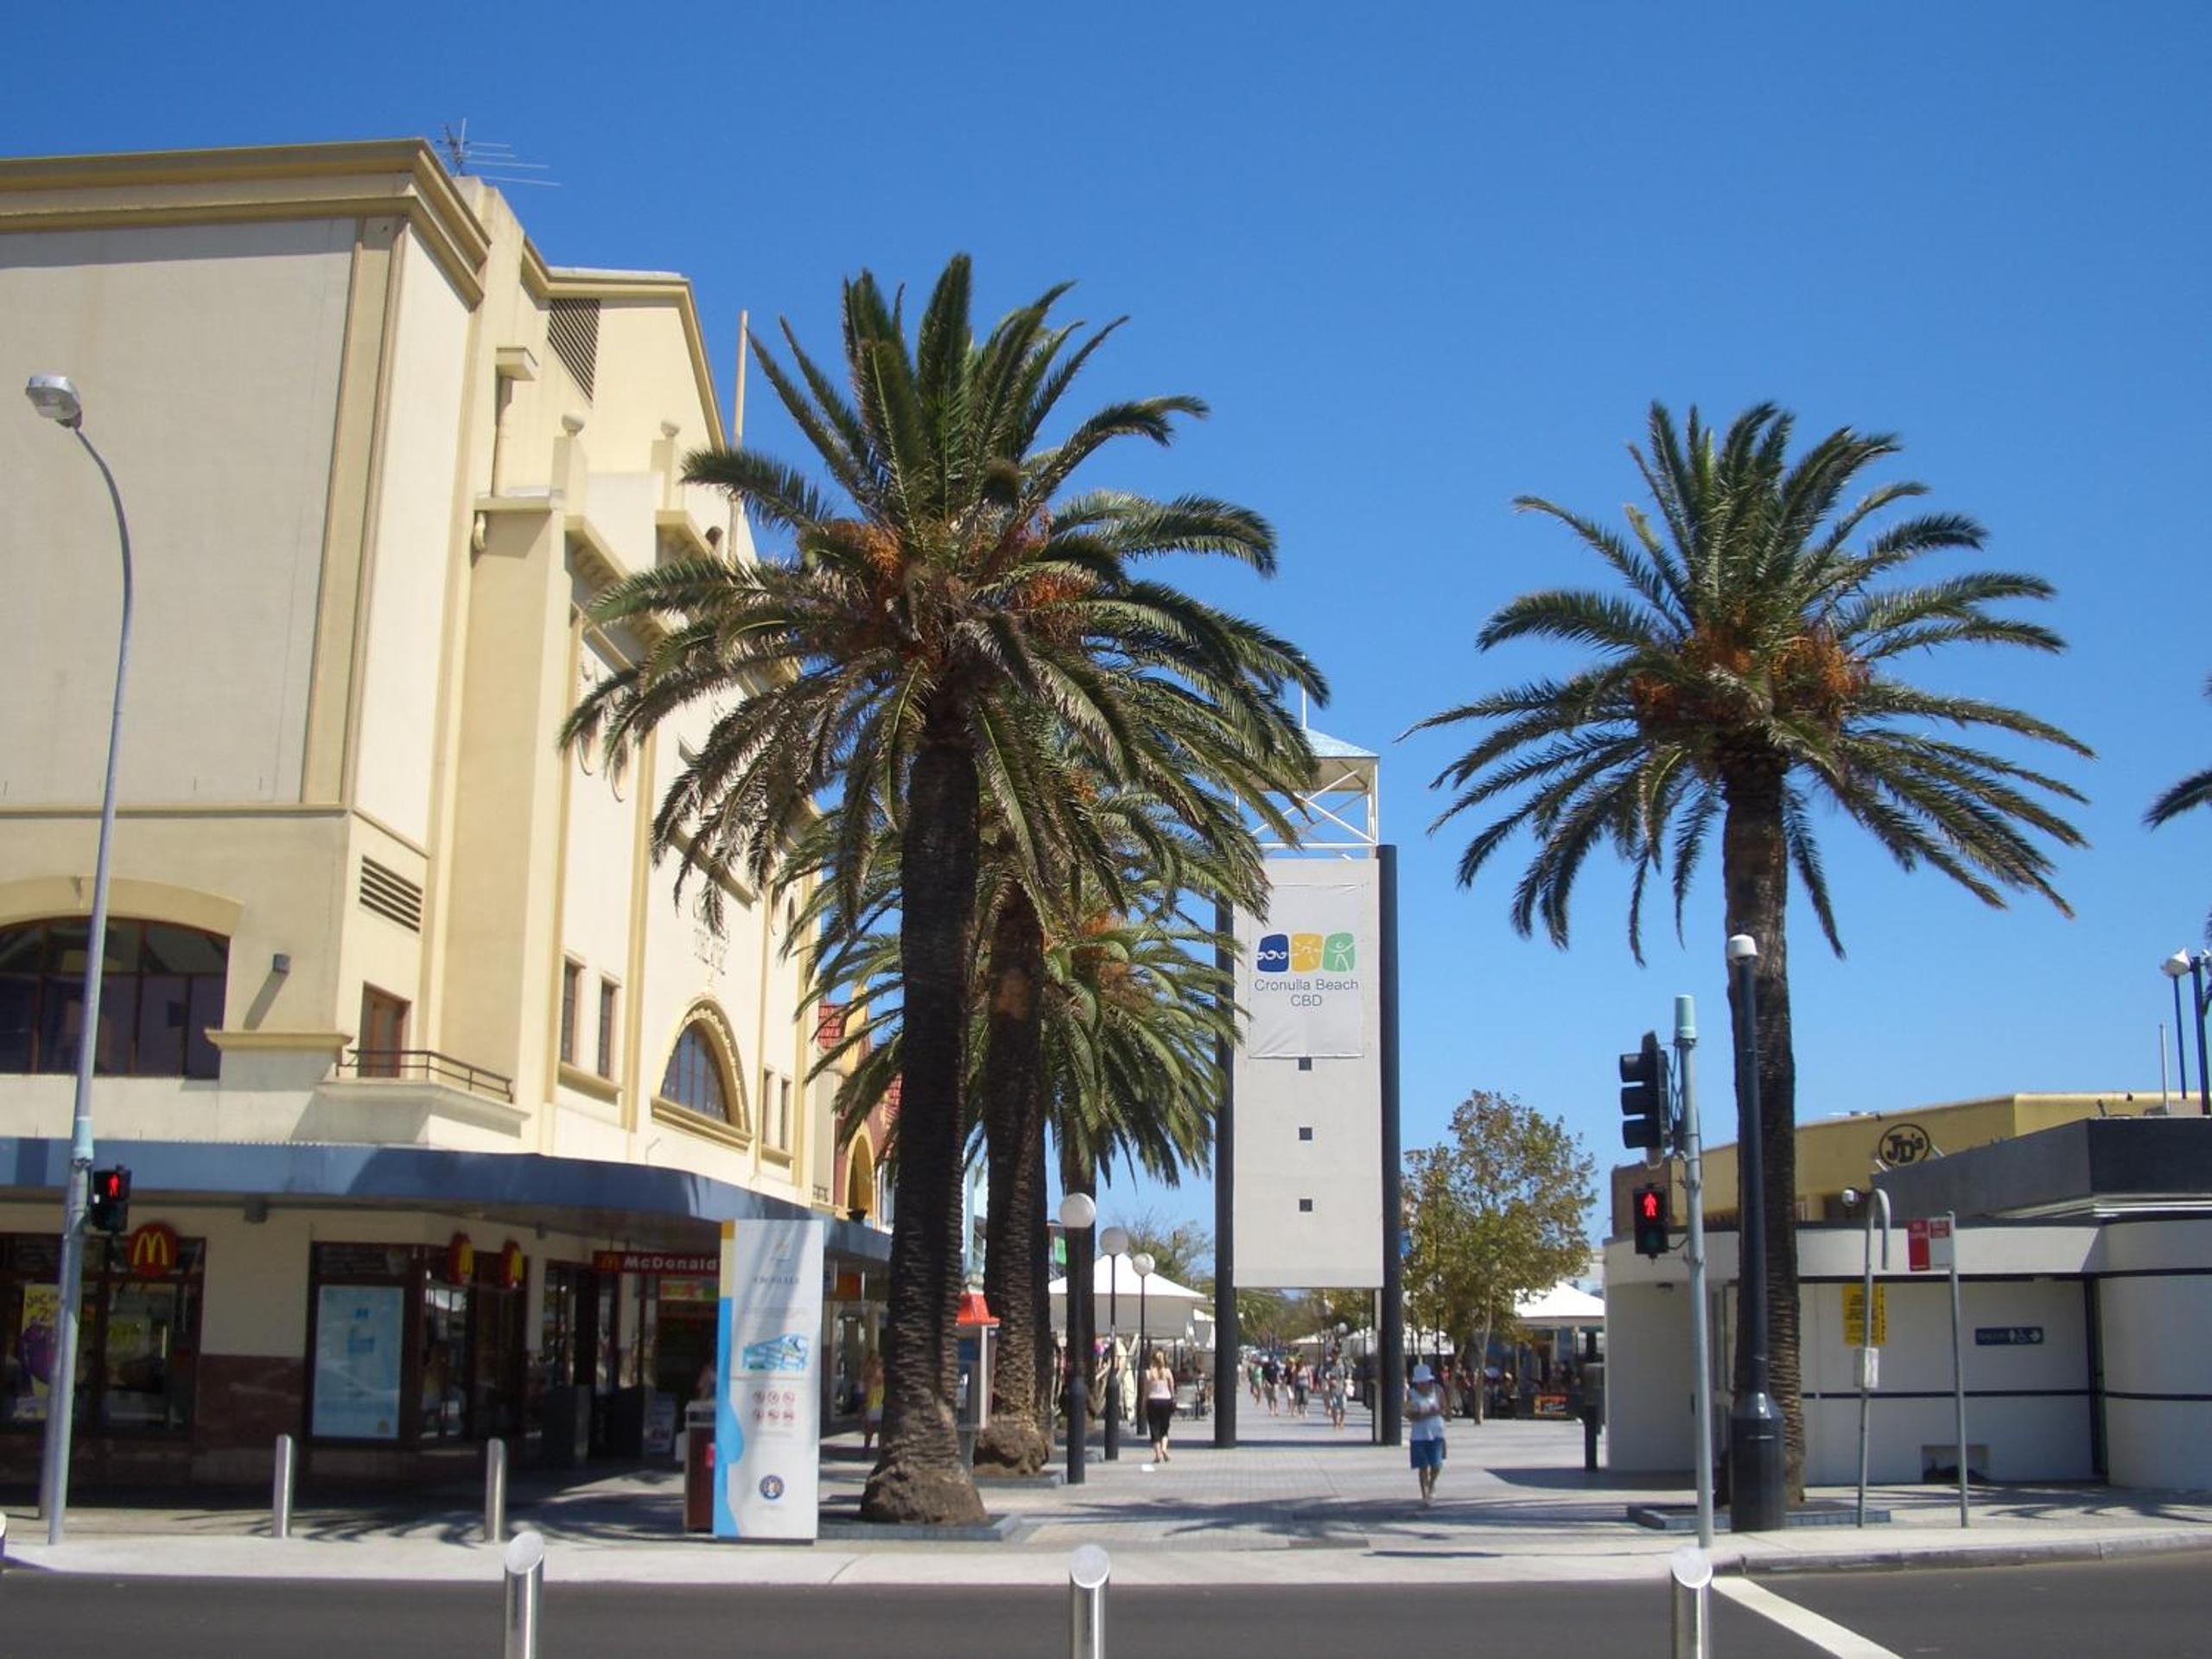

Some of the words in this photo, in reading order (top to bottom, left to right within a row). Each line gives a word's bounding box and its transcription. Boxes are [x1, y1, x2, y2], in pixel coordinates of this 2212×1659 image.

[1254, 978, 1312, 991] Cronulla
[1315, 978, 1359, 991] Beach
[1290, 995, 1323, 1007] CBD
[1886, 1133, 1923, 1163] JD's
[624, 1255, 719, 1270] McDonald
